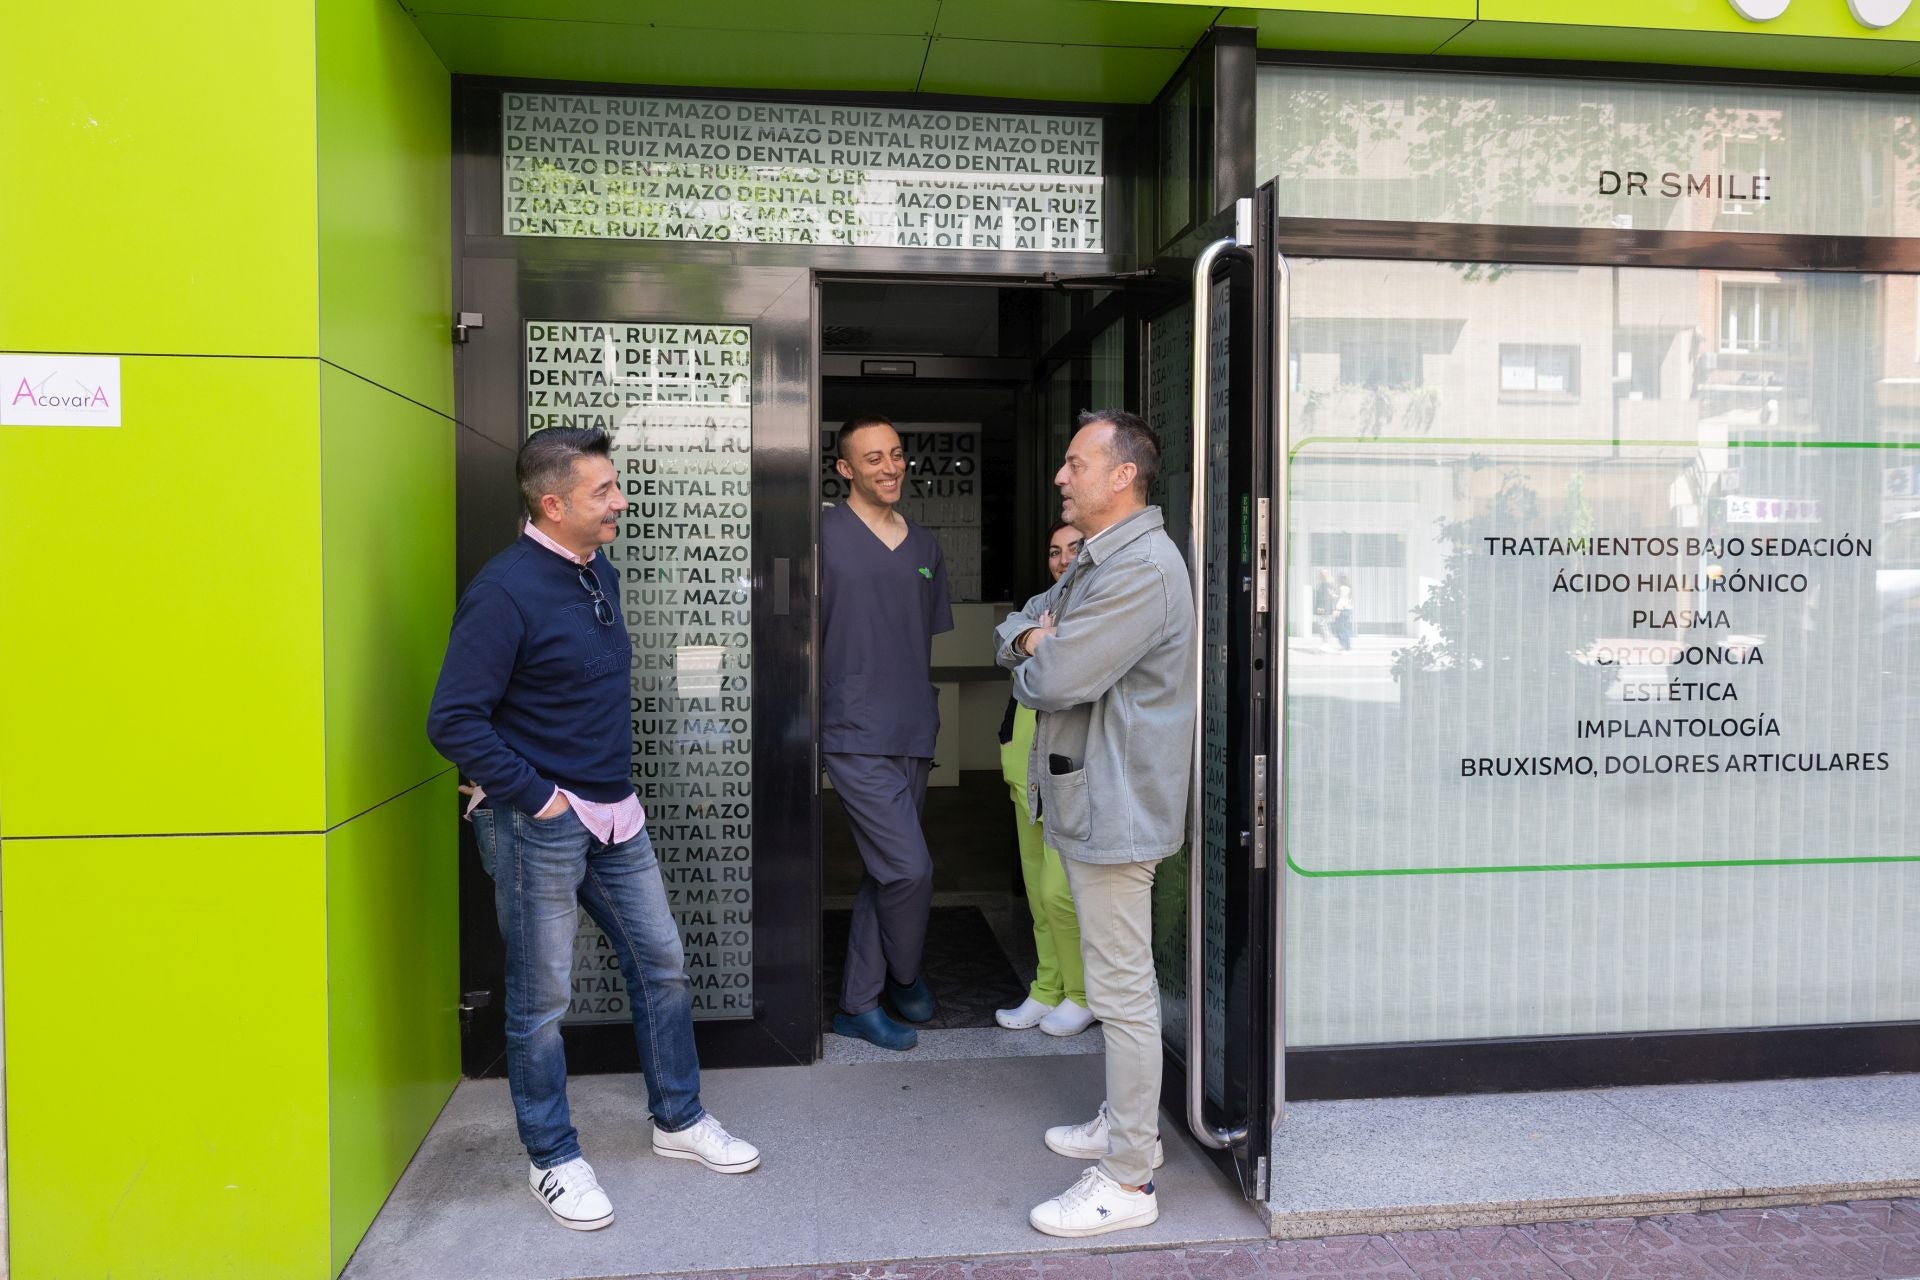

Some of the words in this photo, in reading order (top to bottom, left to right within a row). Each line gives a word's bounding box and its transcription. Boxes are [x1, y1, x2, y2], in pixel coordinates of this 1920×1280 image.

[508, 95, 600, 115] DENTAL
[607, 100, 659, 118] RUIZ
[665, 103, 731, 121] MAZO
[737, 105, 826, 125] DENTAL
[832, 110, 882, 128] RUIZ
[888, 112, 951, 131] MAZO
[956, 116, 1041, 134] DENTAL
[1047, 119, 1096, 137] RUIZ
[506, 115, 526, 131] IZ
[532, 117, 598, 135] MAZO
[605, 119, 696, 139] DENTAL
[701, 124, 752, 142] RUIZ
[758, 127, 822, 144] MAZO
[828, 129, 914, 149] DENTAL
[920, 134, 969, 151] RUIZ
[975, 136, 1037, 154] MAZO
[1041, 139, 1099, 156] DENT
[507, 135, 600, 155] DENTAL
[606, 140, 658, 157] RUIZ
[664, 142, 730, 161] MAZO
[737, 145, 825, 164] DENTAL
[831, 150, 882, 167] RUIZ
[887, 152, 951, 170] MAZO
[956, 155, 1041, 174] DENTAL
[1047, 158, 1096, 175] RUIZ
[506, 155, 526, 171] IZ
[532, 156, 598, 174] MAZO
[604, 160, 694, 178] DENTAL
[700, 163, 751, 181] RUIZ
[1599, 170, 1647, 196] DR
[1660, 172, 1771, 200] SMILE
[507, 197, 527, 213] IZ
[532, 198, 599, 215] MAZO
[607, 180, 659, 197] RUIZ
[665, 183, 731, 200] MAZO
[737, 186, 826, 205] DENTAL
[956, 195, 1042, 213] DENTAL
[1047, 198, 1096, 215] RUIZ
[509, 217, 601, 236] DENTAL
[607, 221, 659, 238] RUIZ
[665, 223, 731, 240] MAZO
[529, 325, 620, 343] DENTAL
[627, 328, 678, 344] RUIZ
[684, 329, 749, 345] MAZO
[528, 347, 548, 363] IZ
[528, 391, 548, 407] IZ
[554, 391, 619, 408] MAZO
[530, 413, 620, 430] DENTAL
[627, 458, 679, 475] RUIZ
[684, 459, 748, 475] MAZO
[627, 480, 716, 496] DENTAL
[722, 480, 750, 497] RU
[627, 502, 678, 518] RUIZ
[683, 502, 748, 518] MAZO
[626, 523, 715, 539] DENTAL
[721, 523, 750, 539] RU
[627, 546, 679, 561] RUIZ
[684, 546, 748, 562] MAZO
[1484, 536, 1679, 557] TRATAMIENTOS
[1686, 538, 1745, 559] BAJO
[1751, 533, 1873, 557] SEDACIÓN
[627, 567, 716, 583] DENTAL
[1552, 568, 1631, 593] ÁCIDO
[1637, 568, 1808, 593] HIALURÓNICO
[626, 590, 678, 605] RUIZ
[683, 589, 748, 605] MAZO
[627, 610, 716, 626] DENTAL
[722, 610, 750, 626] RU
[1632, 610, 1731, 629] PLASMA
[629, 632, 678, 648] RUIZ
[684, 632, 748, 648] MAZO
[1597, 646, 1764, 665] ORTODONCIA
[630, 676, 678, 692] RUIZ
[1622, 677, 1738, 702] ESTÉTICA
[630, 696, 716, 713] DENTAL
[721, 696, 750, 713] RU
[631, 719, 678, 735] RUIZ
[683, 718, 748, 734] MAZO
[1577, 713, 1781, 739] IMPLANTOLOGÍA
[632, 740, 717, 756] DENTAL
[722, 739, 751, 755] RU
[631, 761, 681, 777] RUIZ
[686, 761, 750, 777] MAZO
[1461, 756, 1598, 778] BRUXISMO,
[1605, 754, 1720, 775] DOLORES
[1725, 752, 1890, 773] ARTICULARES
[722, 781, 751, 797] RU
[646, 804, 680, 820] UIZ
[686, 803, 750, 820] MAZO
[722, 824, 751, 839] RU
[686, 846, 750, 862] MAZO
[723, 866, 752, 882] RU
[686, 888, 750, 905] MAZO
[723, 909, 752, 924] RU
[685, 931, 750, 947] MAZO
[722, 951, 751, 967] RU
[689, 973, 750, 989] MAZO
[723, 993, 752, 1009] RU
